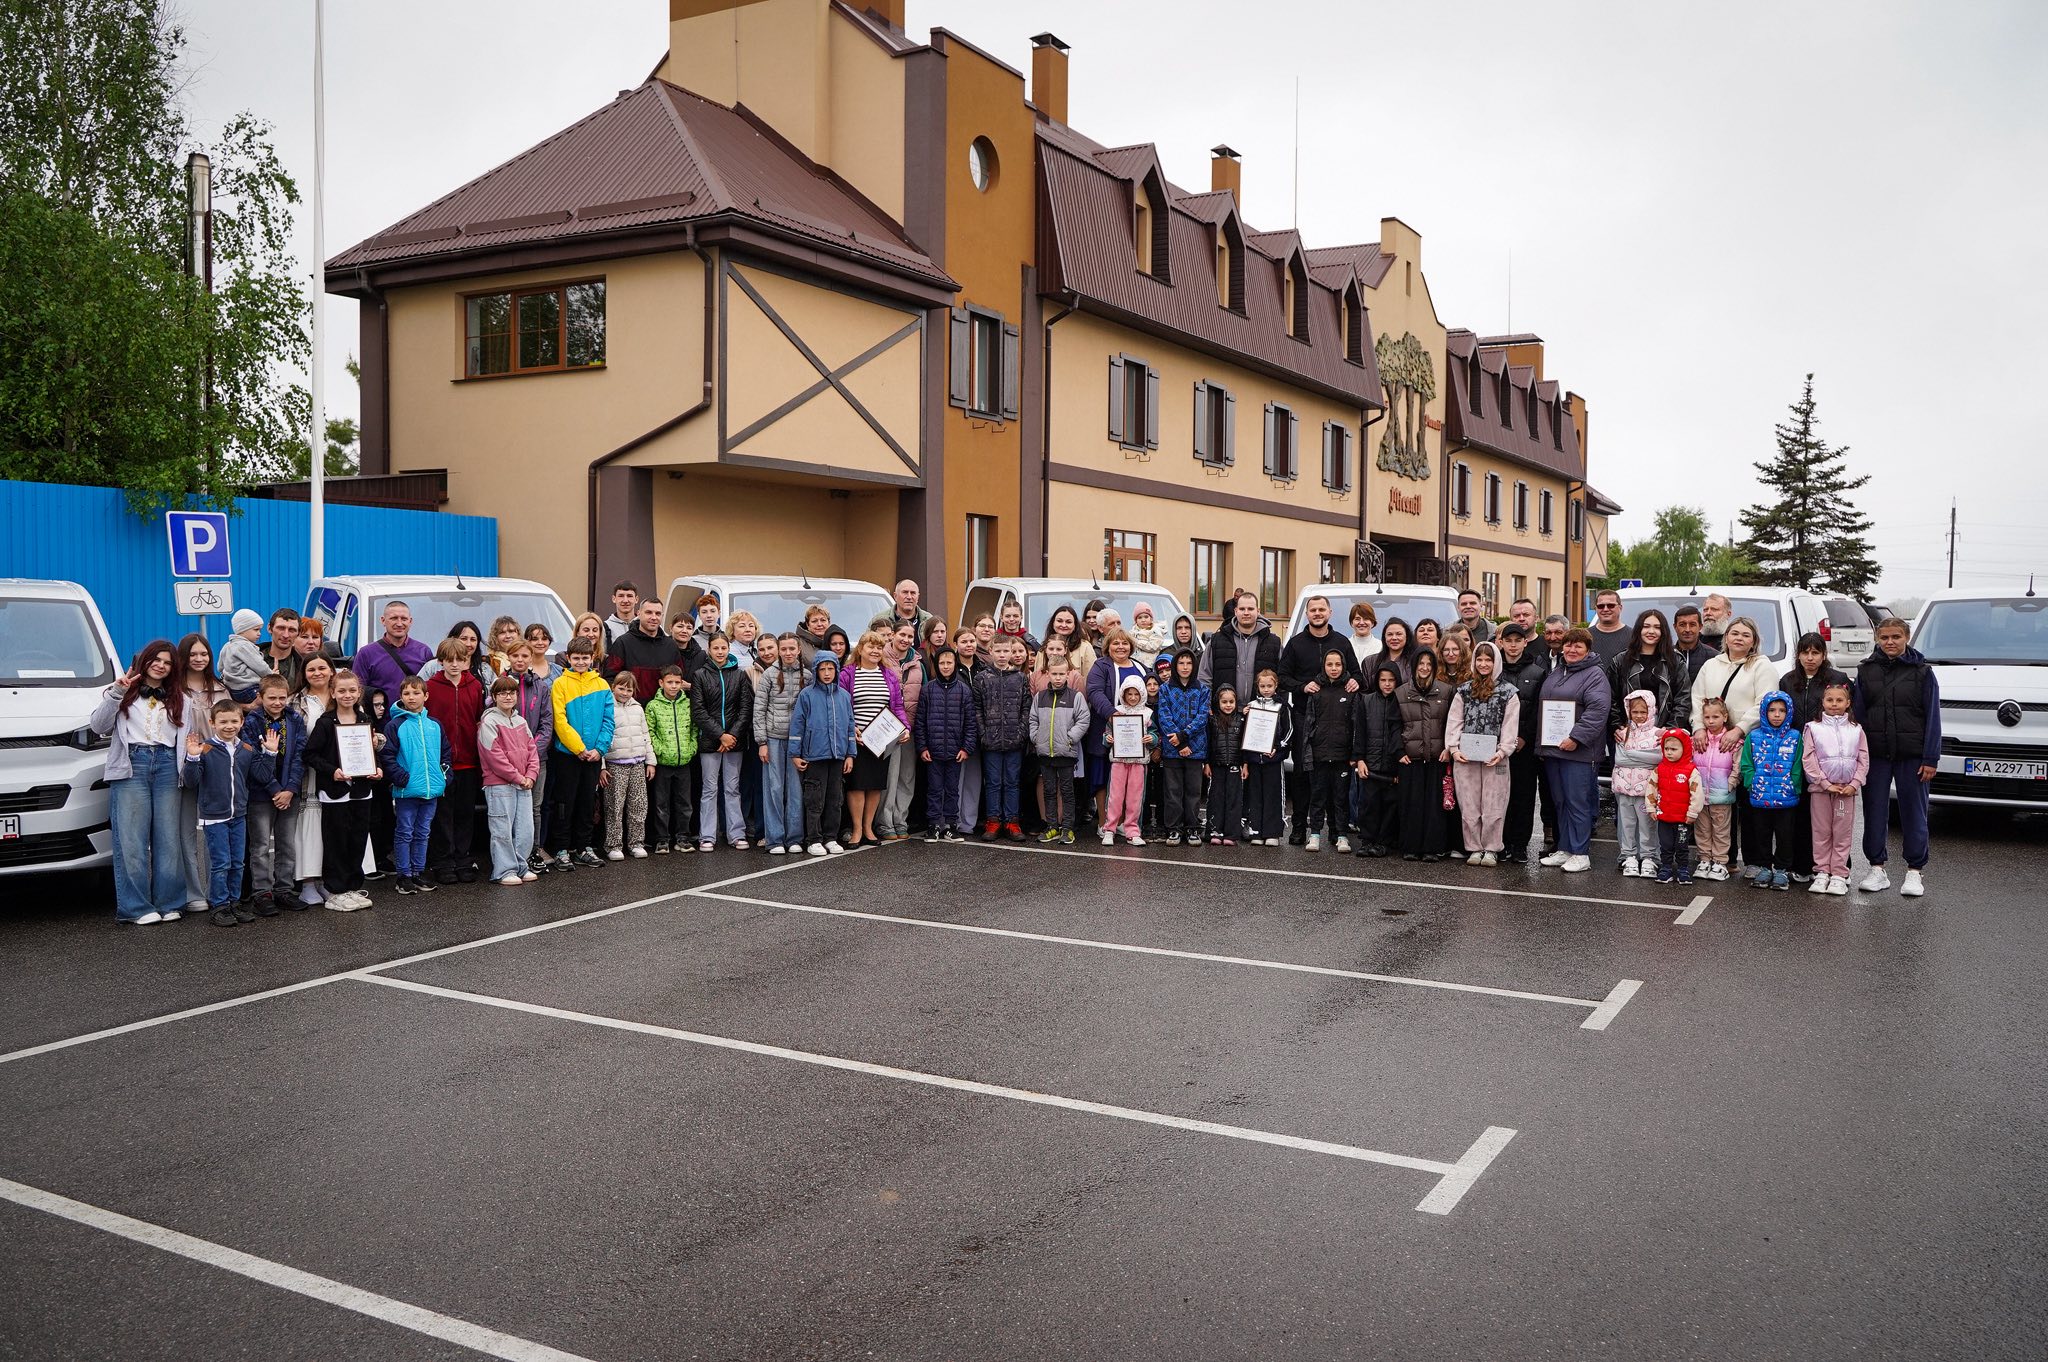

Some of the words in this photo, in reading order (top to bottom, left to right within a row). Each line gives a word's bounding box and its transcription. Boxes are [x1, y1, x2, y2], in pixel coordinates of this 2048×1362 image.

[184, 519, 217, 571] P
[1973, 761, 1991, 773] KA
[1994, 762, 2023, 774] 2297
[2026, 763, 2045, 775] TH
